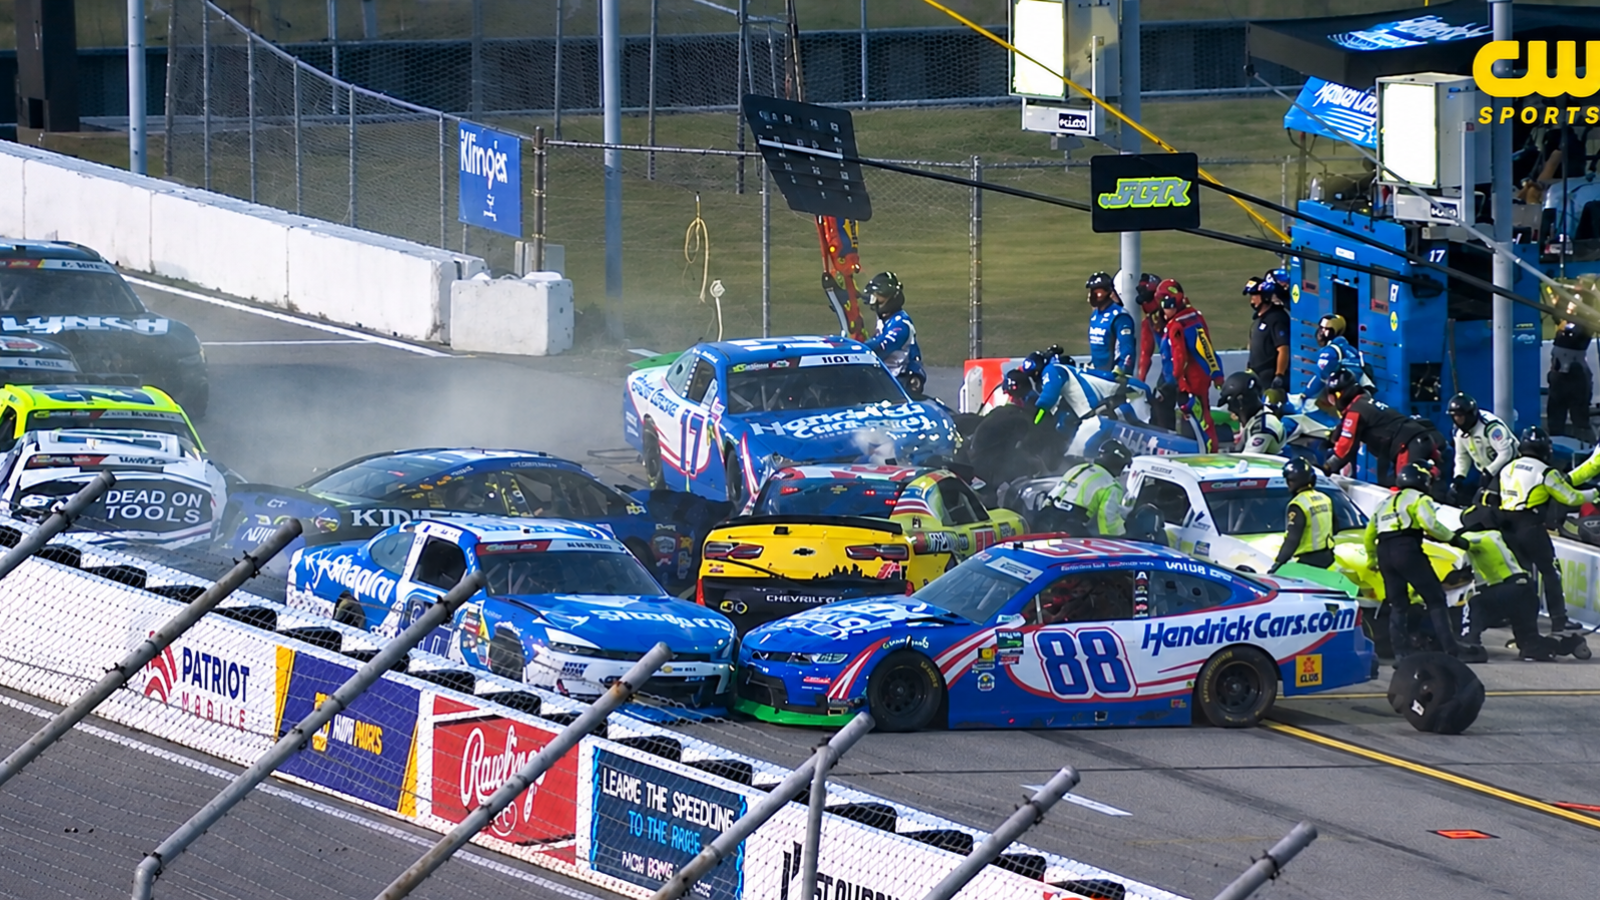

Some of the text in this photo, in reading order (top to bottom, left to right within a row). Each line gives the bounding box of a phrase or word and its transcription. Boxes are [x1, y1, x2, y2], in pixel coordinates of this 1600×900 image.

[1428, 249, 1446, 263] 17
[680, 409, 705, 476] 17
[105, 490, 203, 508] DEAD ON
[106, 505, 201, 524] TOOLS
[182, 646, 250, 703] PATRIOT
[1036, 629, 1134, 697] 88
[646, 782, 668, 813] THE
[628, 810, 644, 837] TO
[647, 816, 668, 844] THE
